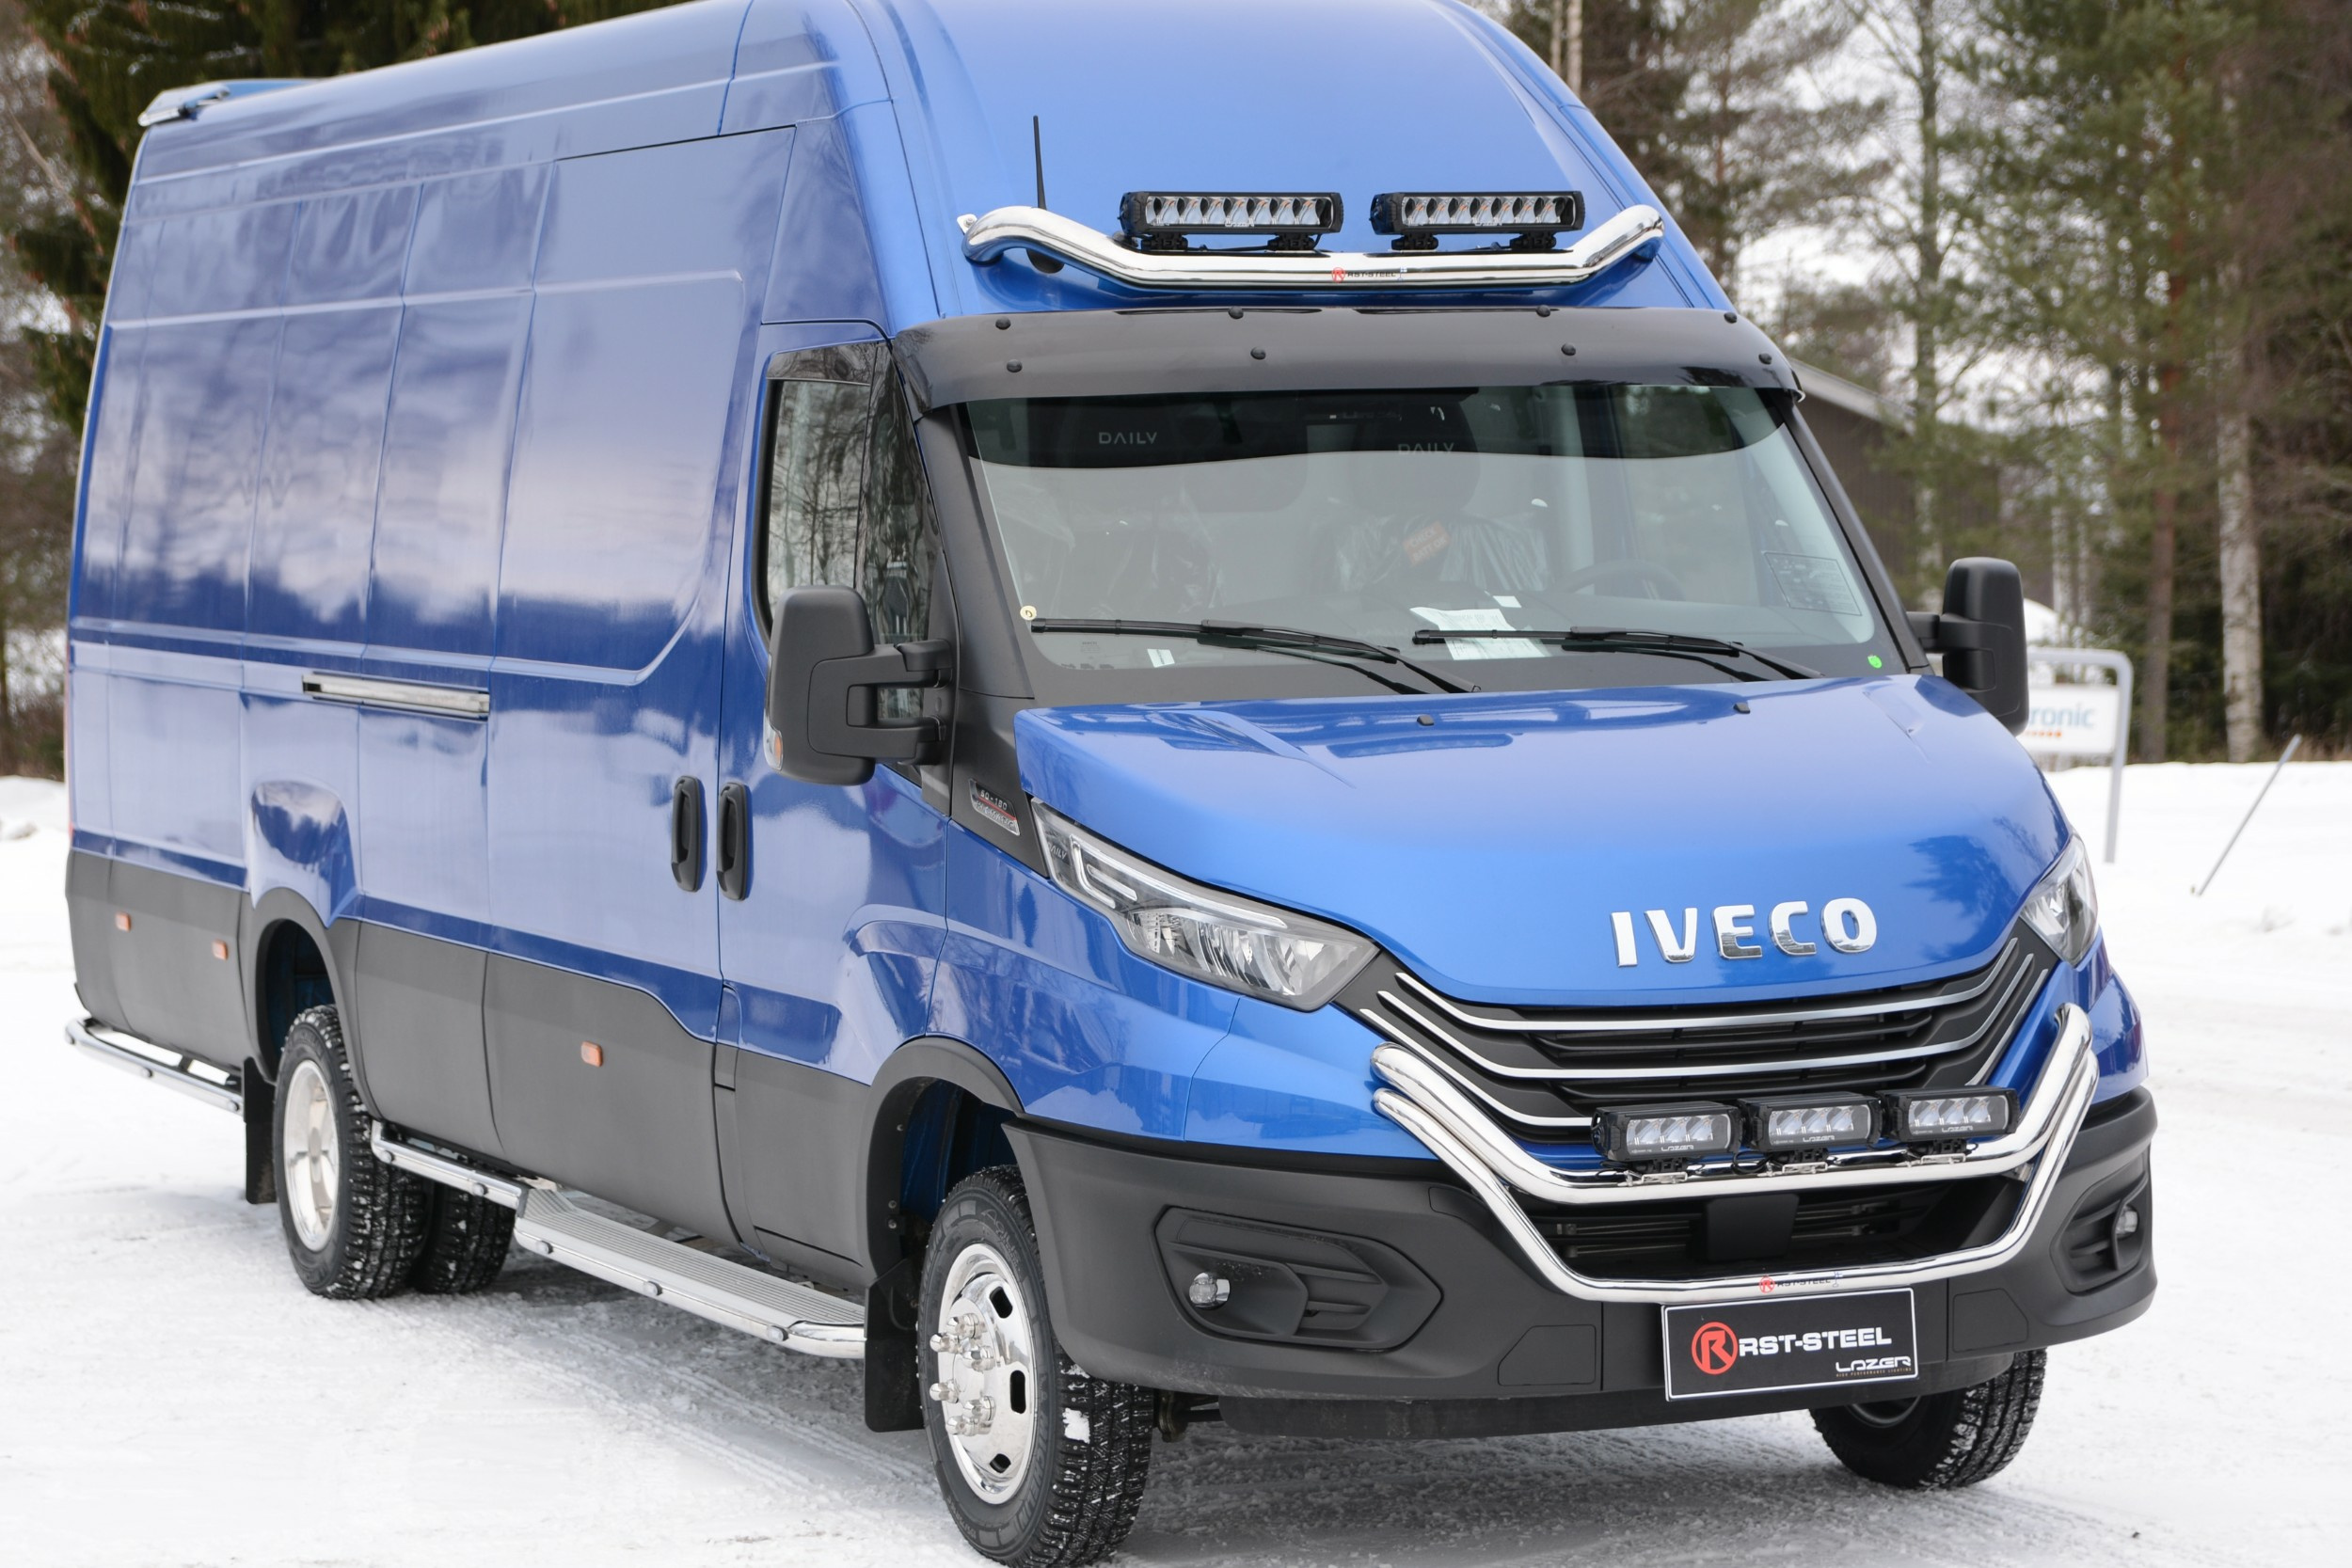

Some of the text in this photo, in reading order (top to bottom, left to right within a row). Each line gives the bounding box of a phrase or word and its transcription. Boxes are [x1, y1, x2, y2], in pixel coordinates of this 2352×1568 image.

[1099, 432, 1157, 444] DAILY
[1398, 442, 1454, 455] DAILY
[1610, 897, 1877, 968] IVECO
[1941, 1125, 1974, 1133] LAZER
[1803, 1134, 1836, 1143] LAZER
[1661, 1144, 1694, 1152] LAZER
[1739, 1326, 1892, 1357] RST-STEEL
[1836, 1355, 1912, 1372] LAZER
